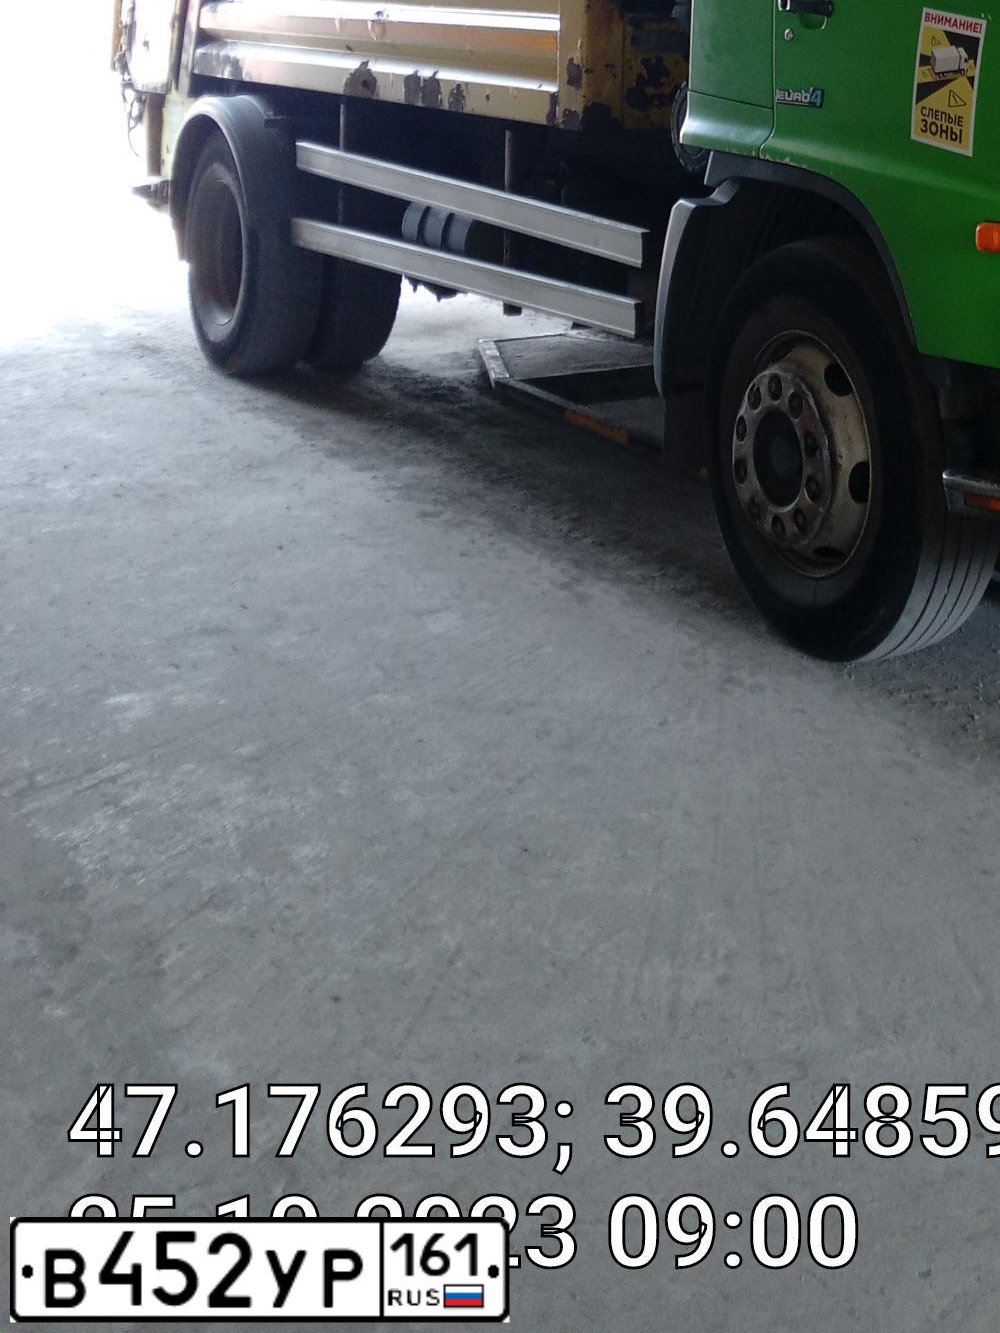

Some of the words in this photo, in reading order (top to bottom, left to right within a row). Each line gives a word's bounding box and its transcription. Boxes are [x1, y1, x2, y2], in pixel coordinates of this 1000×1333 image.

[924, 12, 983, 34] ВНИМАНИЕ!
[921, 106, 964, 128] СЛЕПЫЕ
[920, 119, 963, 144] ЗОНЫ
